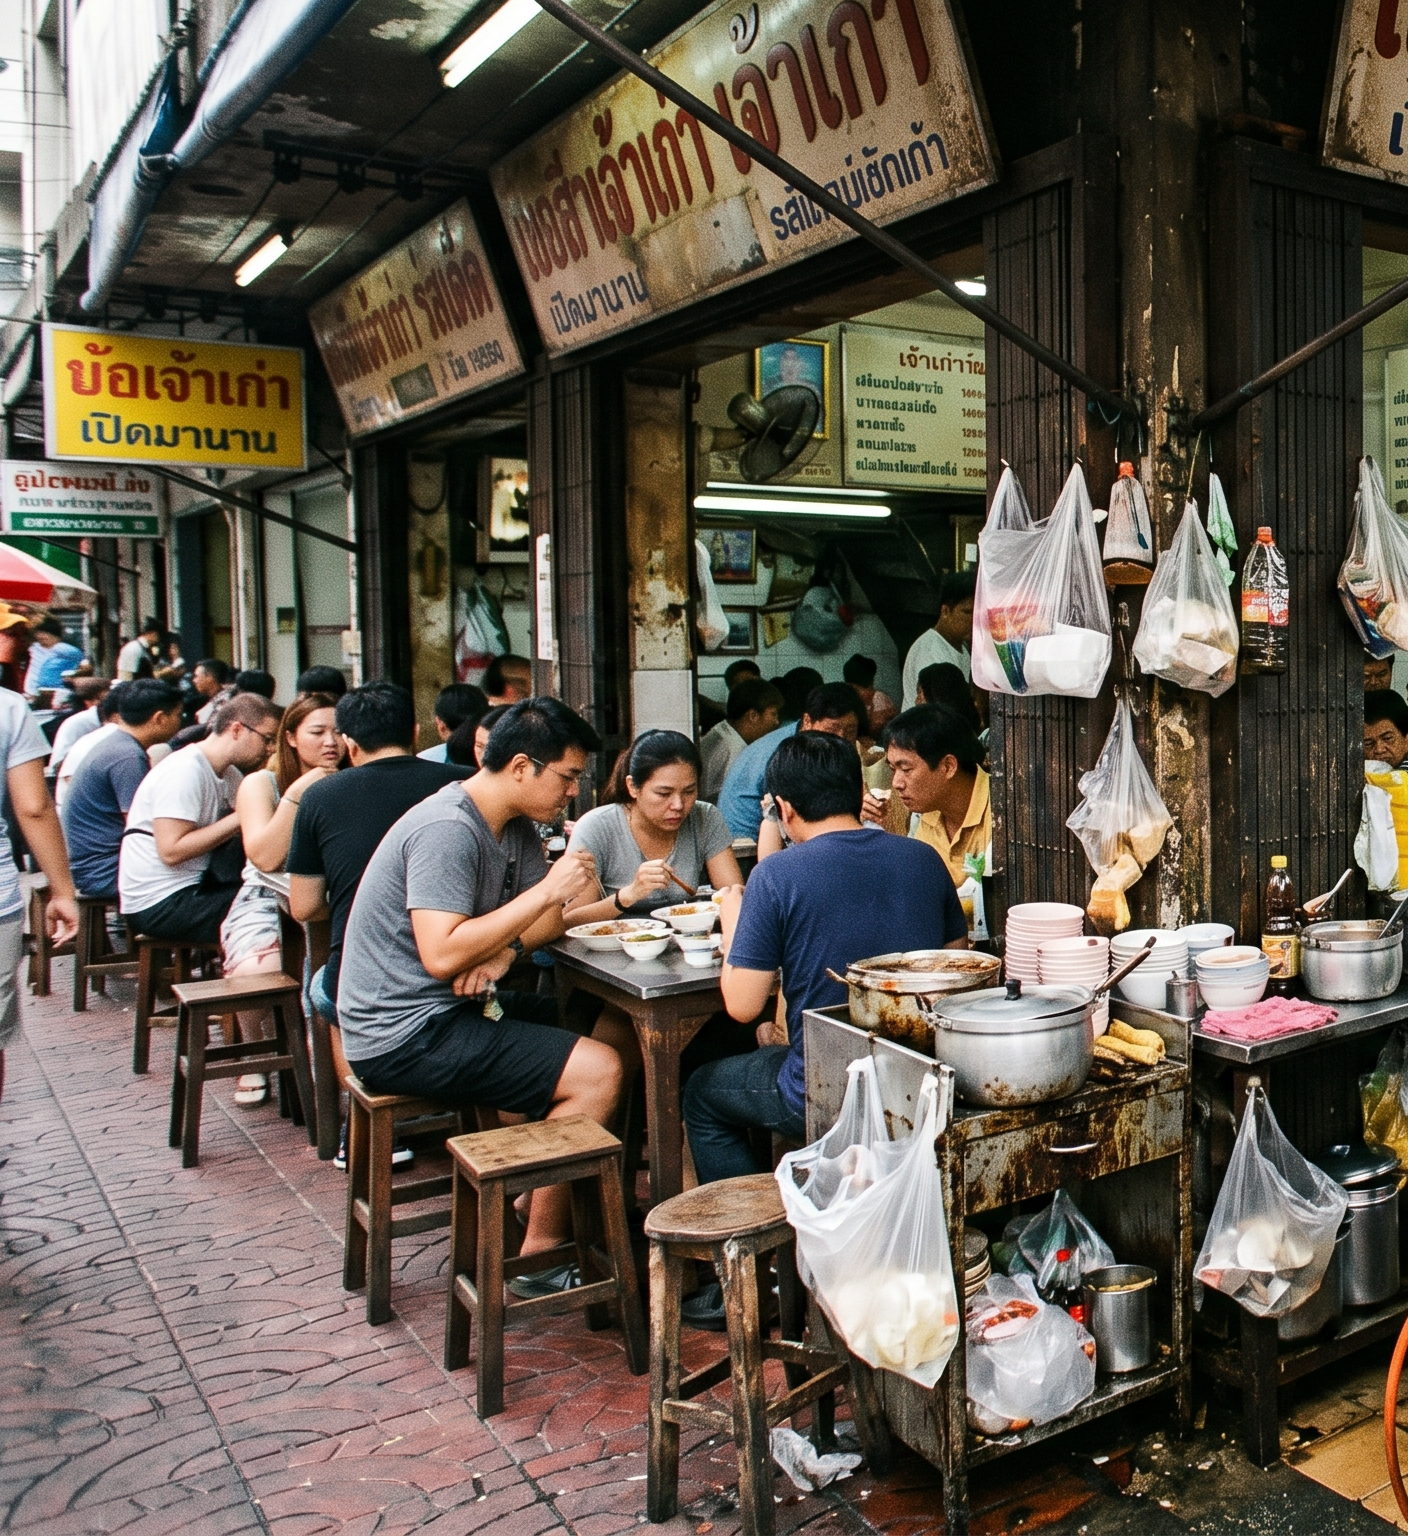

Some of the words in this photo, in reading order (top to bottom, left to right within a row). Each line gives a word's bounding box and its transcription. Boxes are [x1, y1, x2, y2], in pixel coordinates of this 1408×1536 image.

[549, 267, 650, 337] เปิดมานาน
[82, 411, 277, 454] เปิดมานาน
